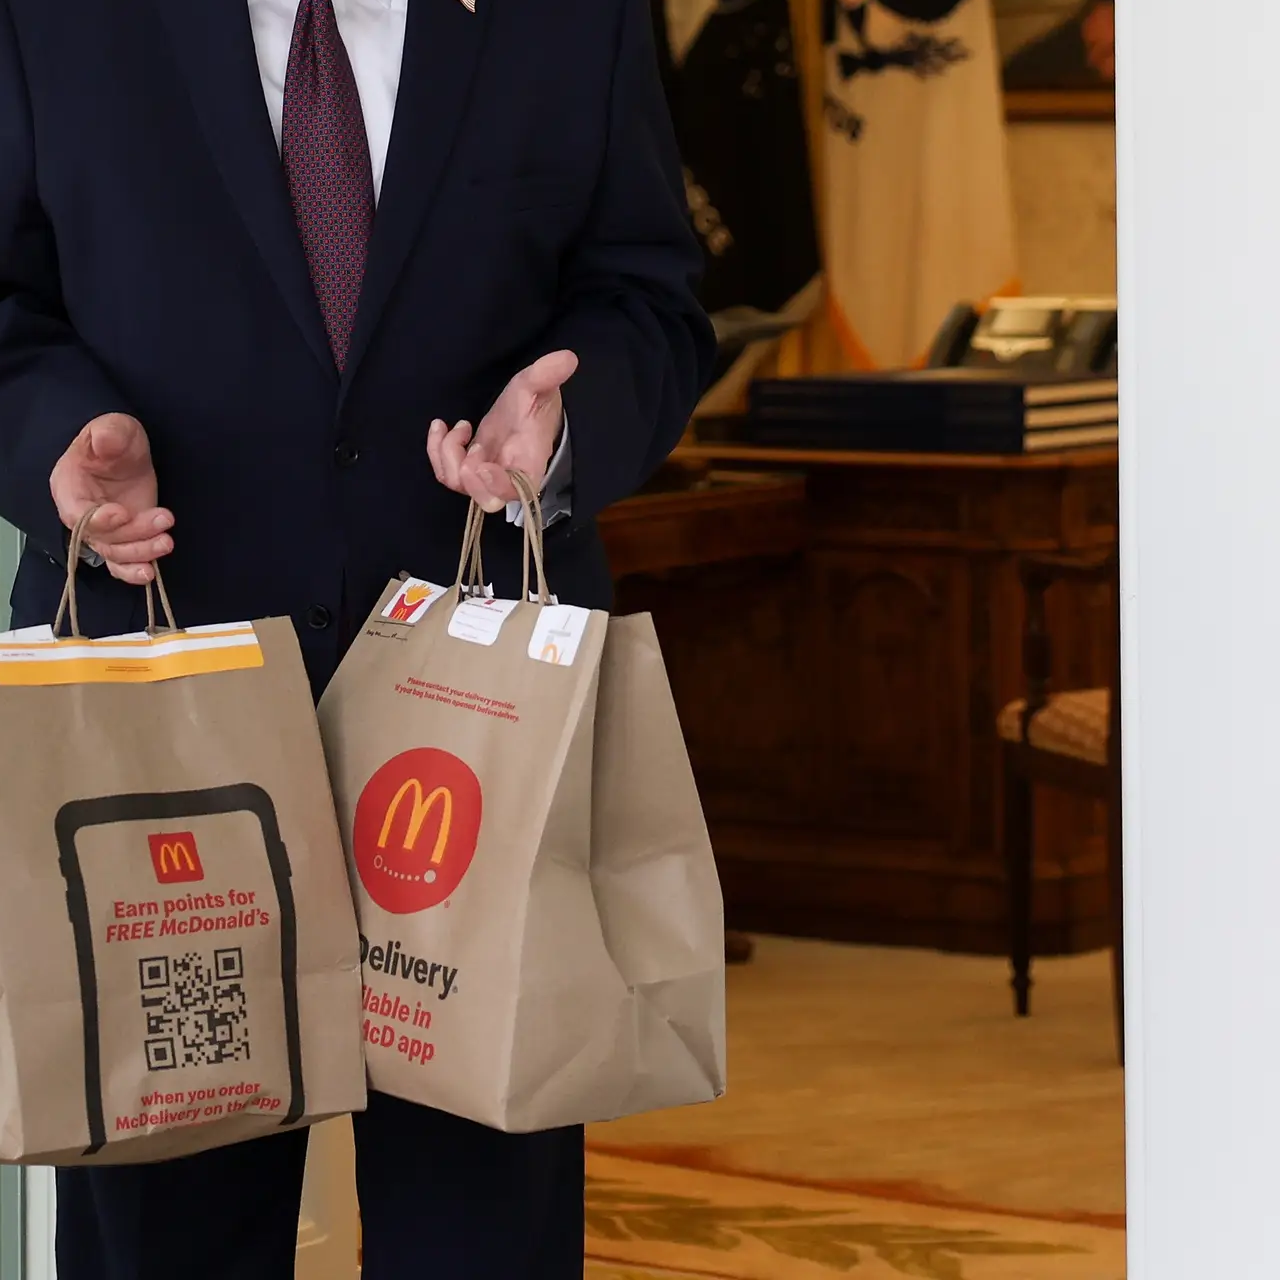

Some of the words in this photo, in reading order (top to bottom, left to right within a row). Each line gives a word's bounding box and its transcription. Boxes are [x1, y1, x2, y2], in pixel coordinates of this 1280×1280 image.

[399, 686, 413, 694] your
[412, 688, 424, 699] bag
[424, 691, 435, 700] has
[436, 695, 452, 704] been
[452, 699, 476, 711] opened
[476, 705, 498, 716] before
[497, 710, 519, 723] delivery
[407, 676, 425, 687] Please
[425, 681, 449, 693] contact
[449, 688, 465, 697] your
[465, 691, 491, 705] delivery
[491, 699, 516, 710] provider
[113, 901, 159, 919] Earn
[163, 893, 225, 918] points
[228, 889, 256, 906] for
[106, 921, 155, 943] FREE
[159, 908, 270, 937] McDonald's
[412, 1001, 432, 1030] in
[397, 1034, 435, 1065] app
[140, 1089, 184, 1107] when
[187, 1087, 216, 1105] you
[219, 1081, 261, 1096] order
[115, 1107, 201, 1131] McDelivery
[204, 1103, 223, 1116] on
[251, 1096, 281, 1111] app
